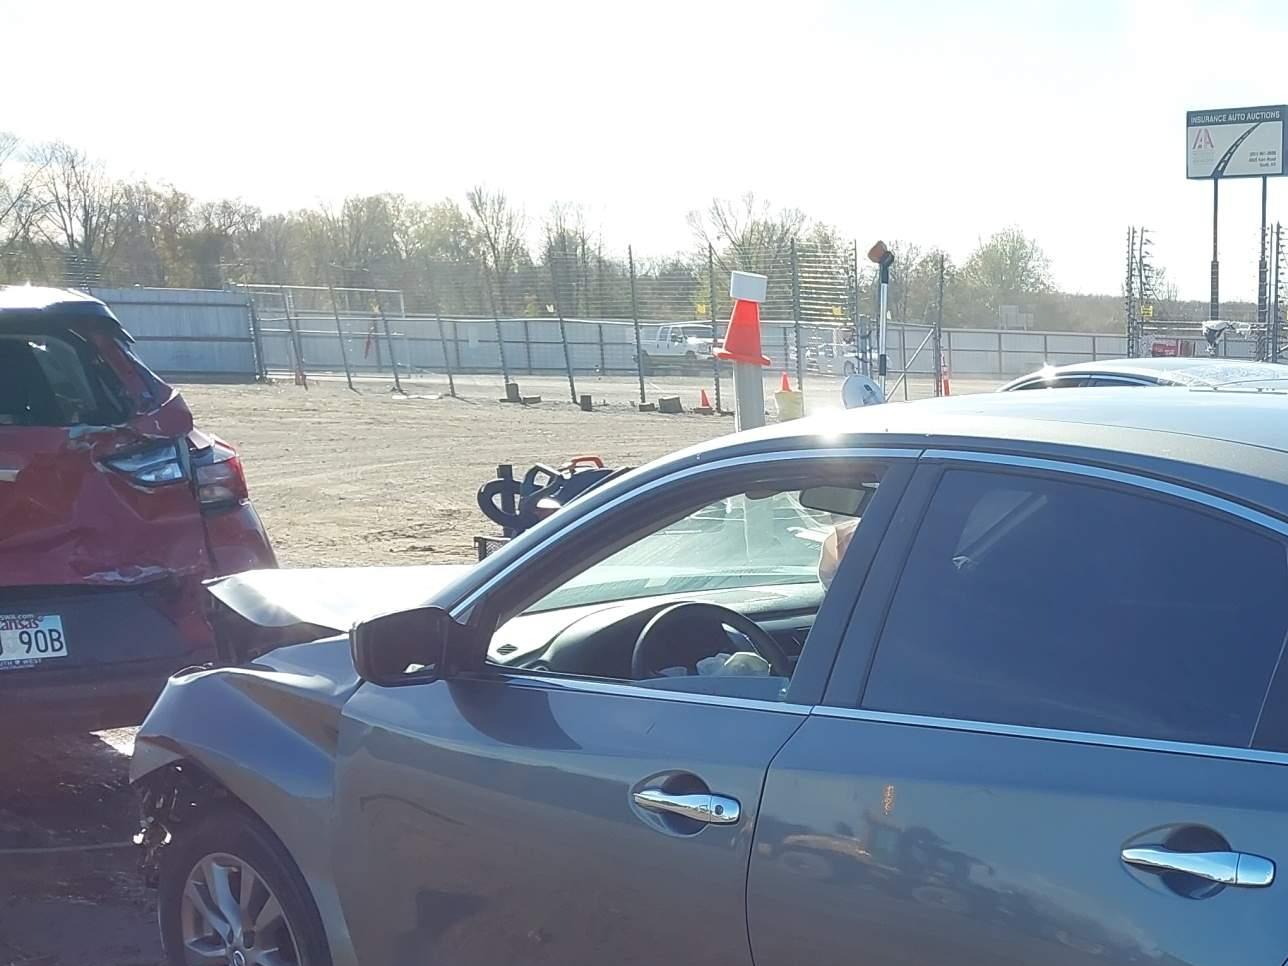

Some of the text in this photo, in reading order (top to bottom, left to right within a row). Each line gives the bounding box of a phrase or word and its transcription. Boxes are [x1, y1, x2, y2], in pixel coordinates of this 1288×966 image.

[1190, 110, 1280, 123] INSURANCE AUTO AUCTIONS
[0, 618, 39, 631] ansas
[18, 628, 64, 654] 90B
